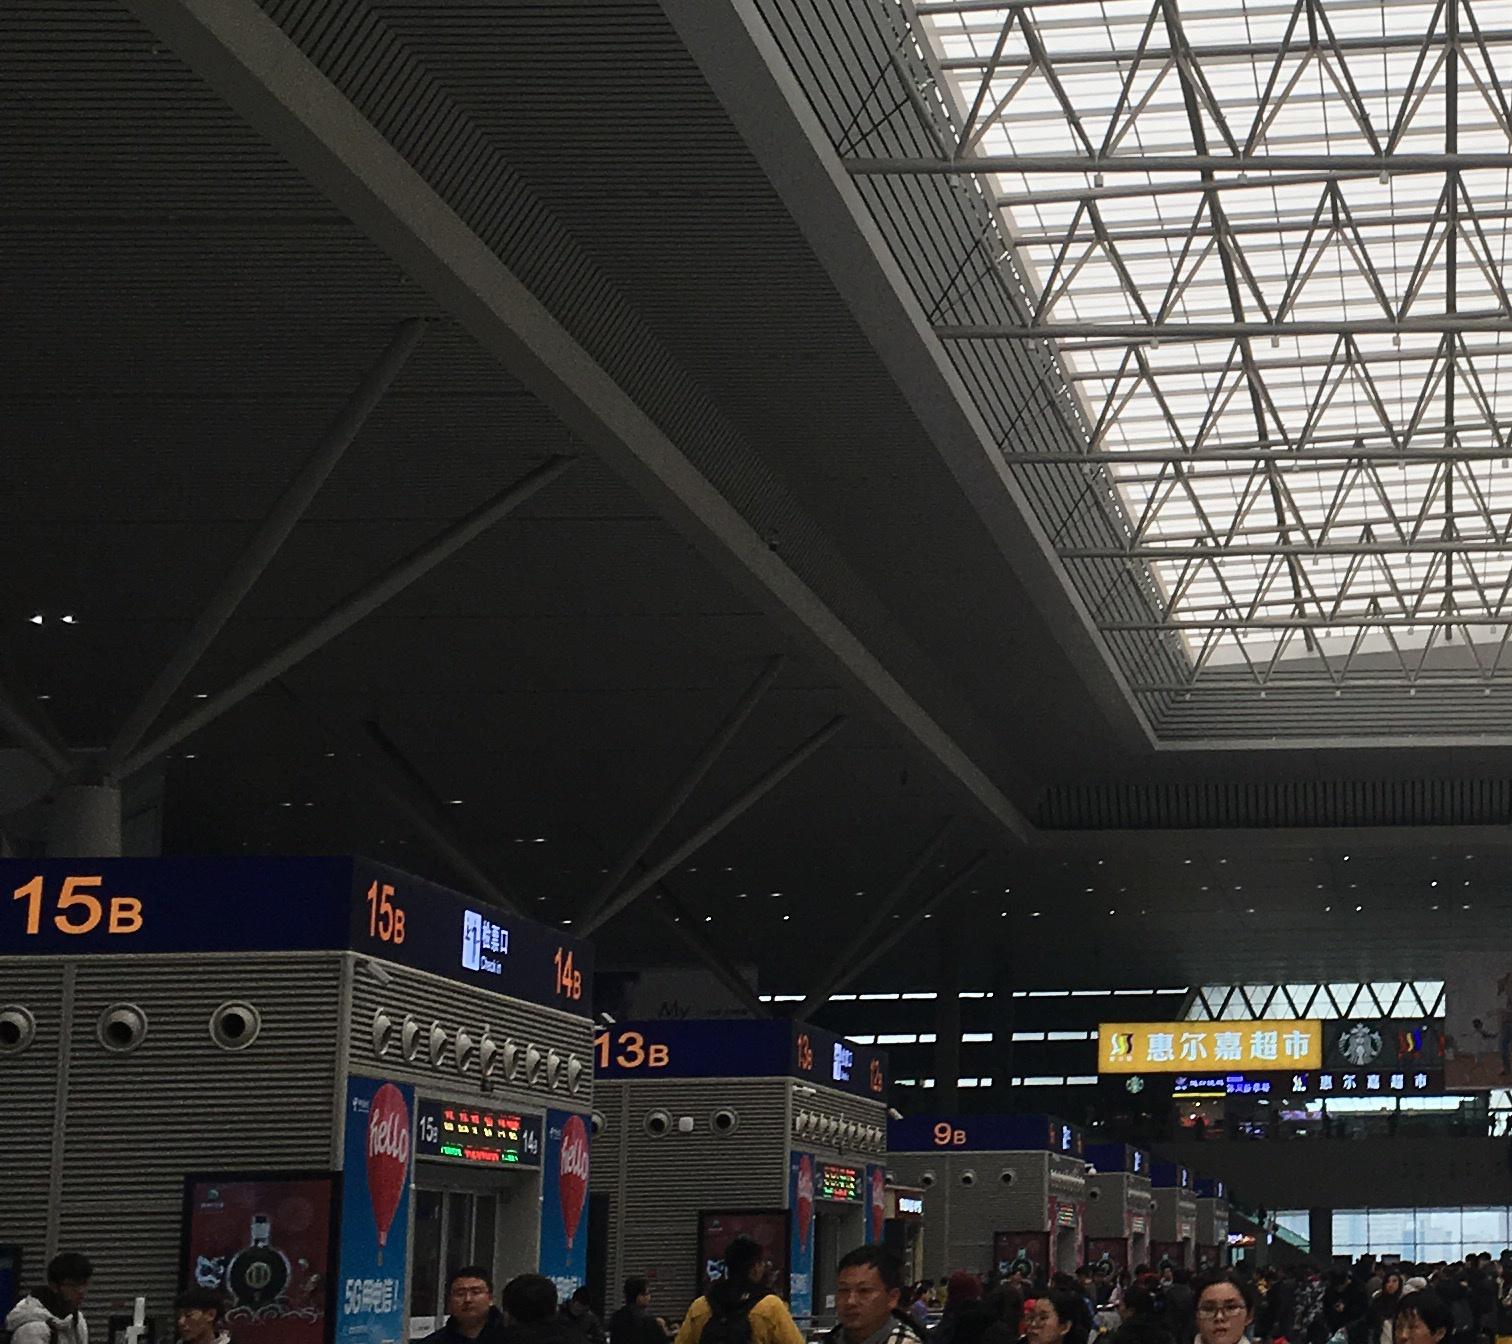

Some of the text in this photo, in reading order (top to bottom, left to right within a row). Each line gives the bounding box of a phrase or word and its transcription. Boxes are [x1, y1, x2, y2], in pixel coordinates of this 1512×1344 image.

[14, 875, 144, 935] 15B
[367, 880, 406, 945] 15B
[555, 947, 582, 1001] 14B
[593, 1030, 671, 1069] 13B
[1146, 1030, 1312, 1062] 惠尔嘉超市
[1319, 1073, 1430, 1091] 惠尔嘉超市
[369, 1108, 409, 1164] hello
[933, 1122, 967, 1146] 9B
[560, 1135, 590, 1181] hello
